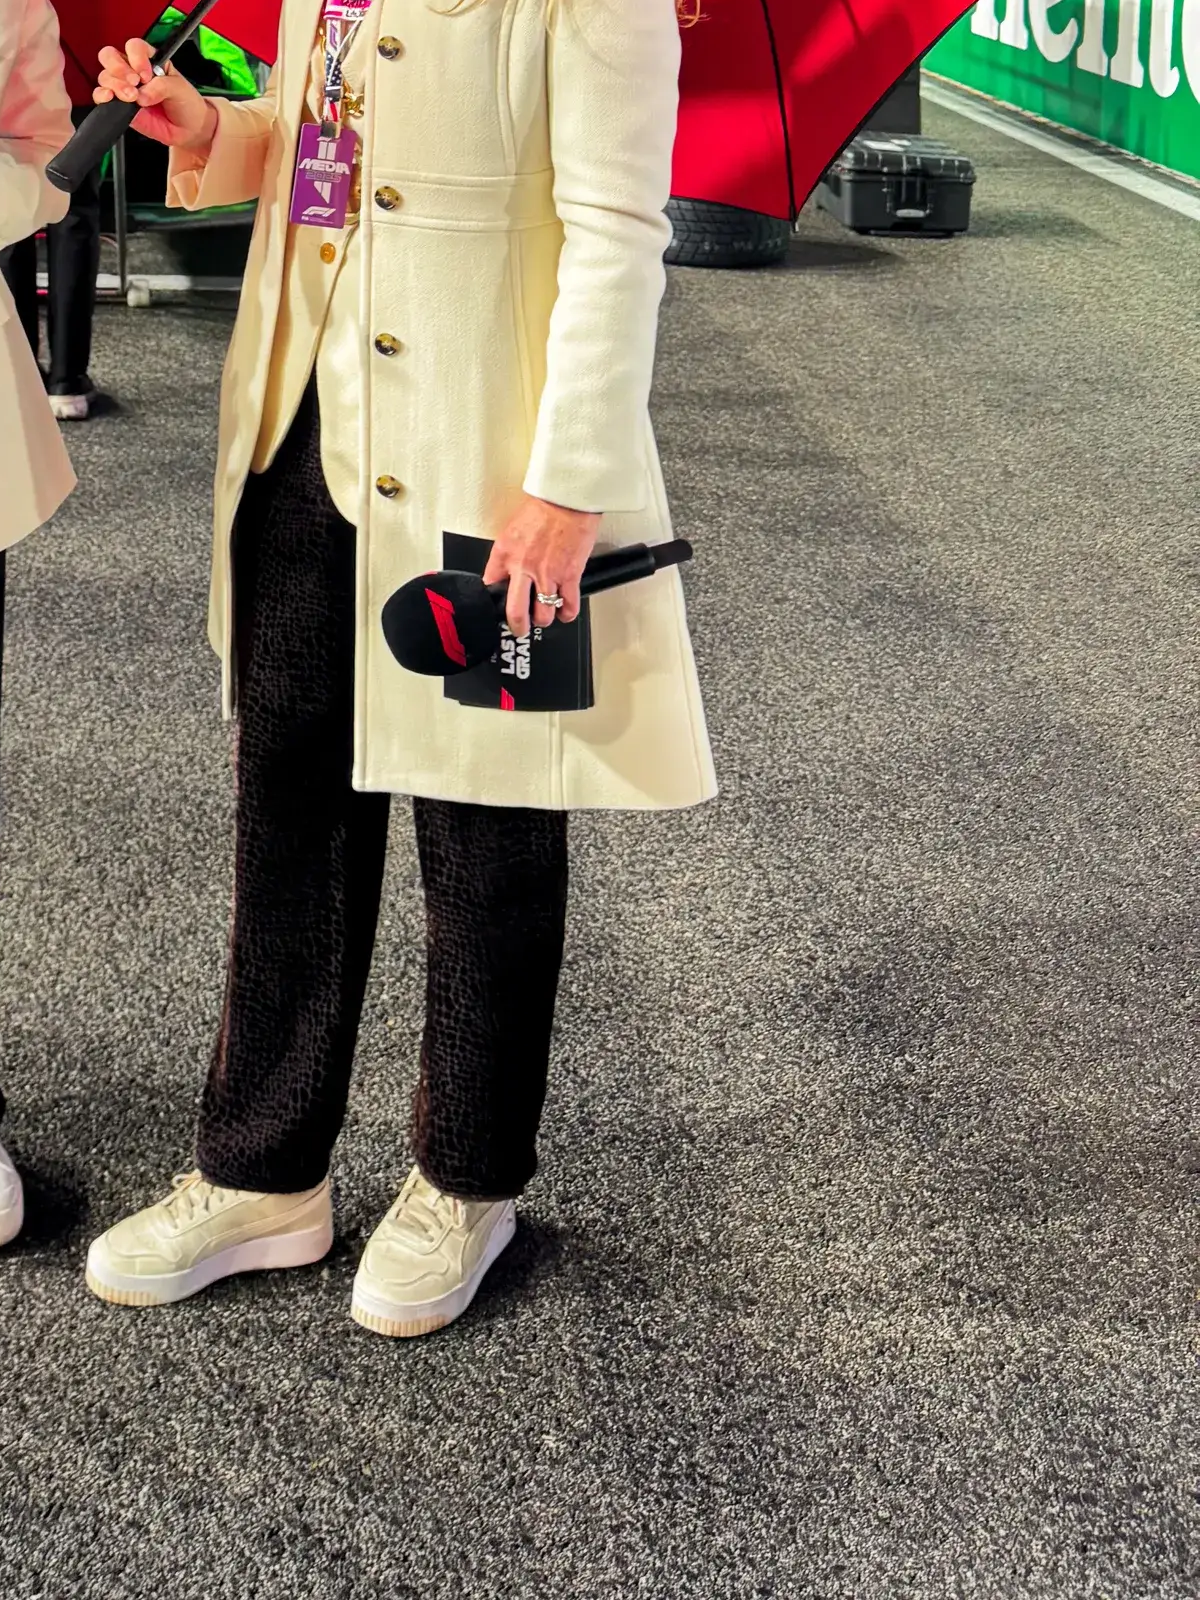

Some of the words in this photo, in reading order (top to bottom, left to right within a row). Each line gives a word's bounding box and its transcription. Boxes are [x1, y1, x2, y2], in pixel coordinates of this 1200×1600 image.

[299, 158, 351, 175] MEDIA
[534, 627, 542, 640] 20
[501, 639, 515, 675] LAS
[516, 631, 530, 679] GRAN
